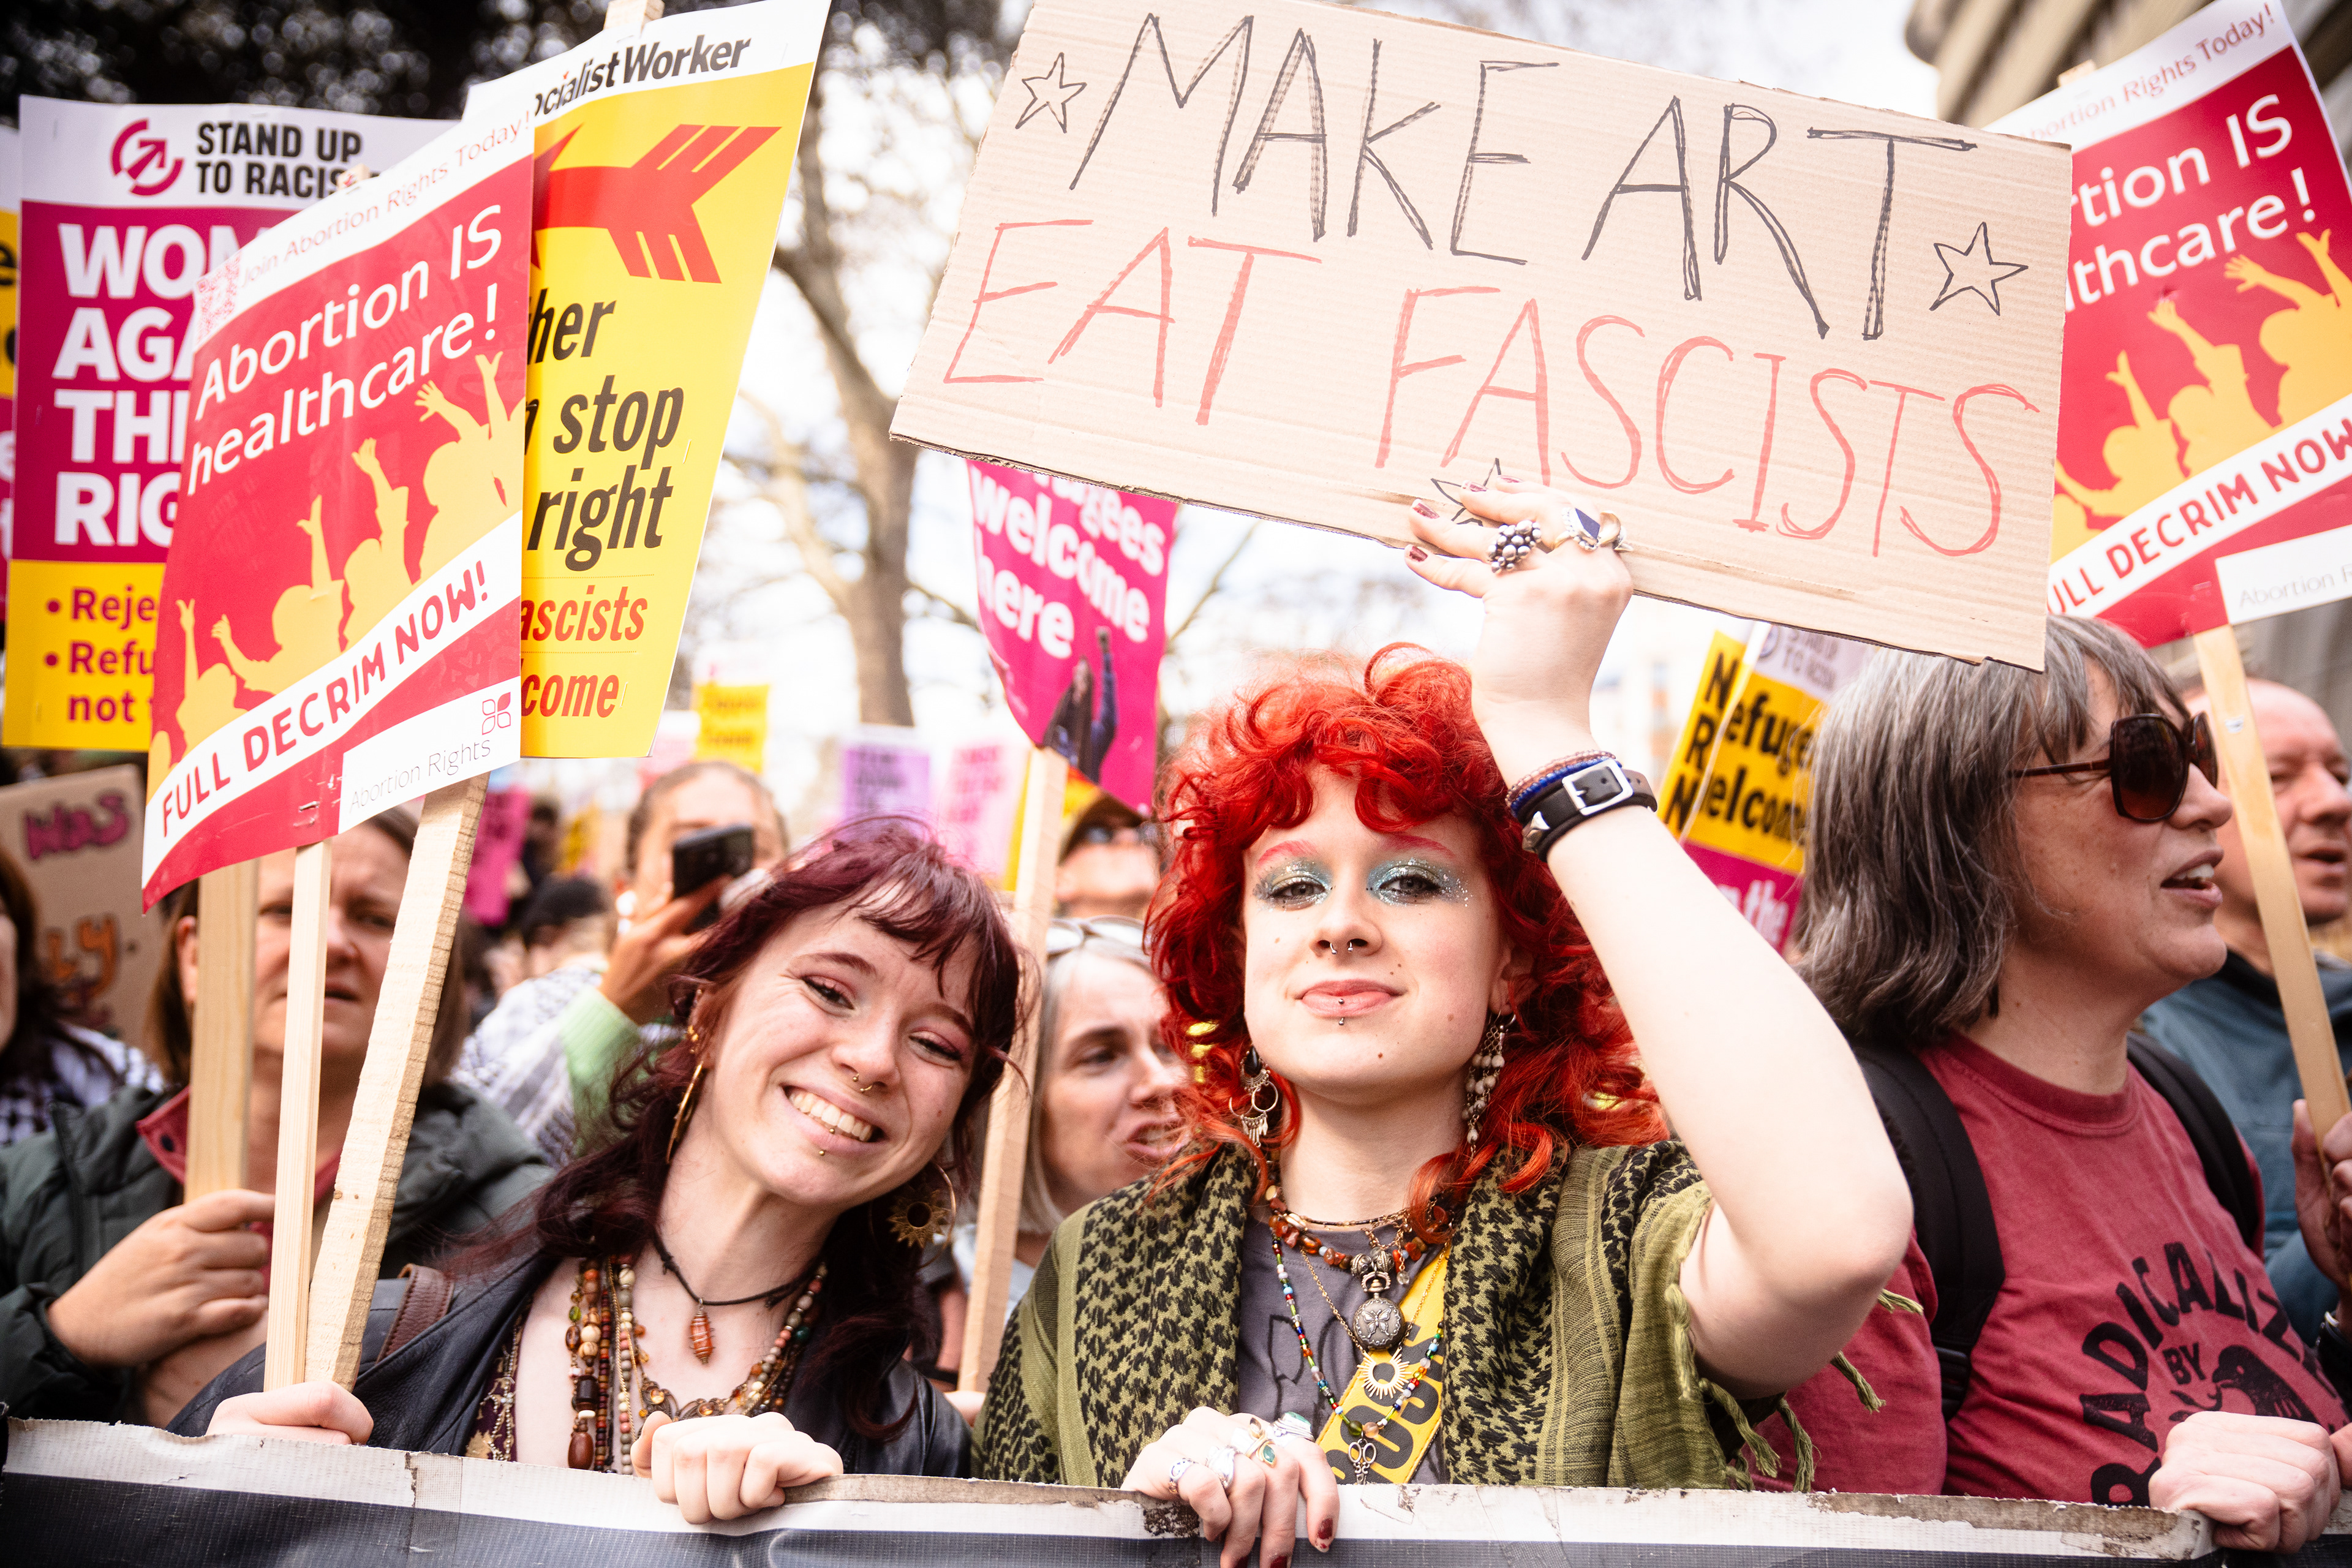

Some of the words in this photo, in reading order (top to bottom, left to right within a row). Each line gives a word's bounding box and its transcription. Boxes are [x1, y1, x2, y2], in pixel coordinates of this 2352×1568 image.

[2019, 96, 2116, 140] bortion
[2122, 53, 2197, 102] Rights
[2195, 2, 2274, 61] Today!
[196, 161, 233, 194] TO
[197, 121, 303, 157] STAND
[316, 127, 363, 164] UP
[1069, 13, 1560, 265] MAKE
[1581, 95, 1978, 341] ART
[2071, 146, 2211, 227] tion
[2226, 94, 2293, 168] IS
[241, 255, 280, 287] Join
[284, 204, 379, 262] Abortion
[386, 162, 448, 213] Rights
[455, 110, 530, 167] Today!
[194, 260, 429, 422] Abortion
[450, 204, 502, 281] IS
[527, 288, 617, 365] her
[187, 282, 497, 497] healthcare!
[553, 374, 685, 470] stop
[944, 219, 1322, 425] EAT
[1375, 285, 2040, 557] FASCISTS
[526, 464, 674, 571] right
[970, 464, 1150, 643] welcome
[2106, 473, 2258, 579] DECRIM
[70, 584, 156, 630] Reje
[974, 525, 1075, 660] here
[2239, 573, 2335, 608] Abortion
[67, 690, 135, 723] not
[162, 752, 231, 838] FULL
[243, 641, 386, 772] DECRIM
[395, 560, 488, 665] NOW!
[521, 658, 619, 718] come
[349, 764, 420, 814] Abortion
[428, 739, 491, 776] Rights
[2162, 1342, 2206, 1385] BY
